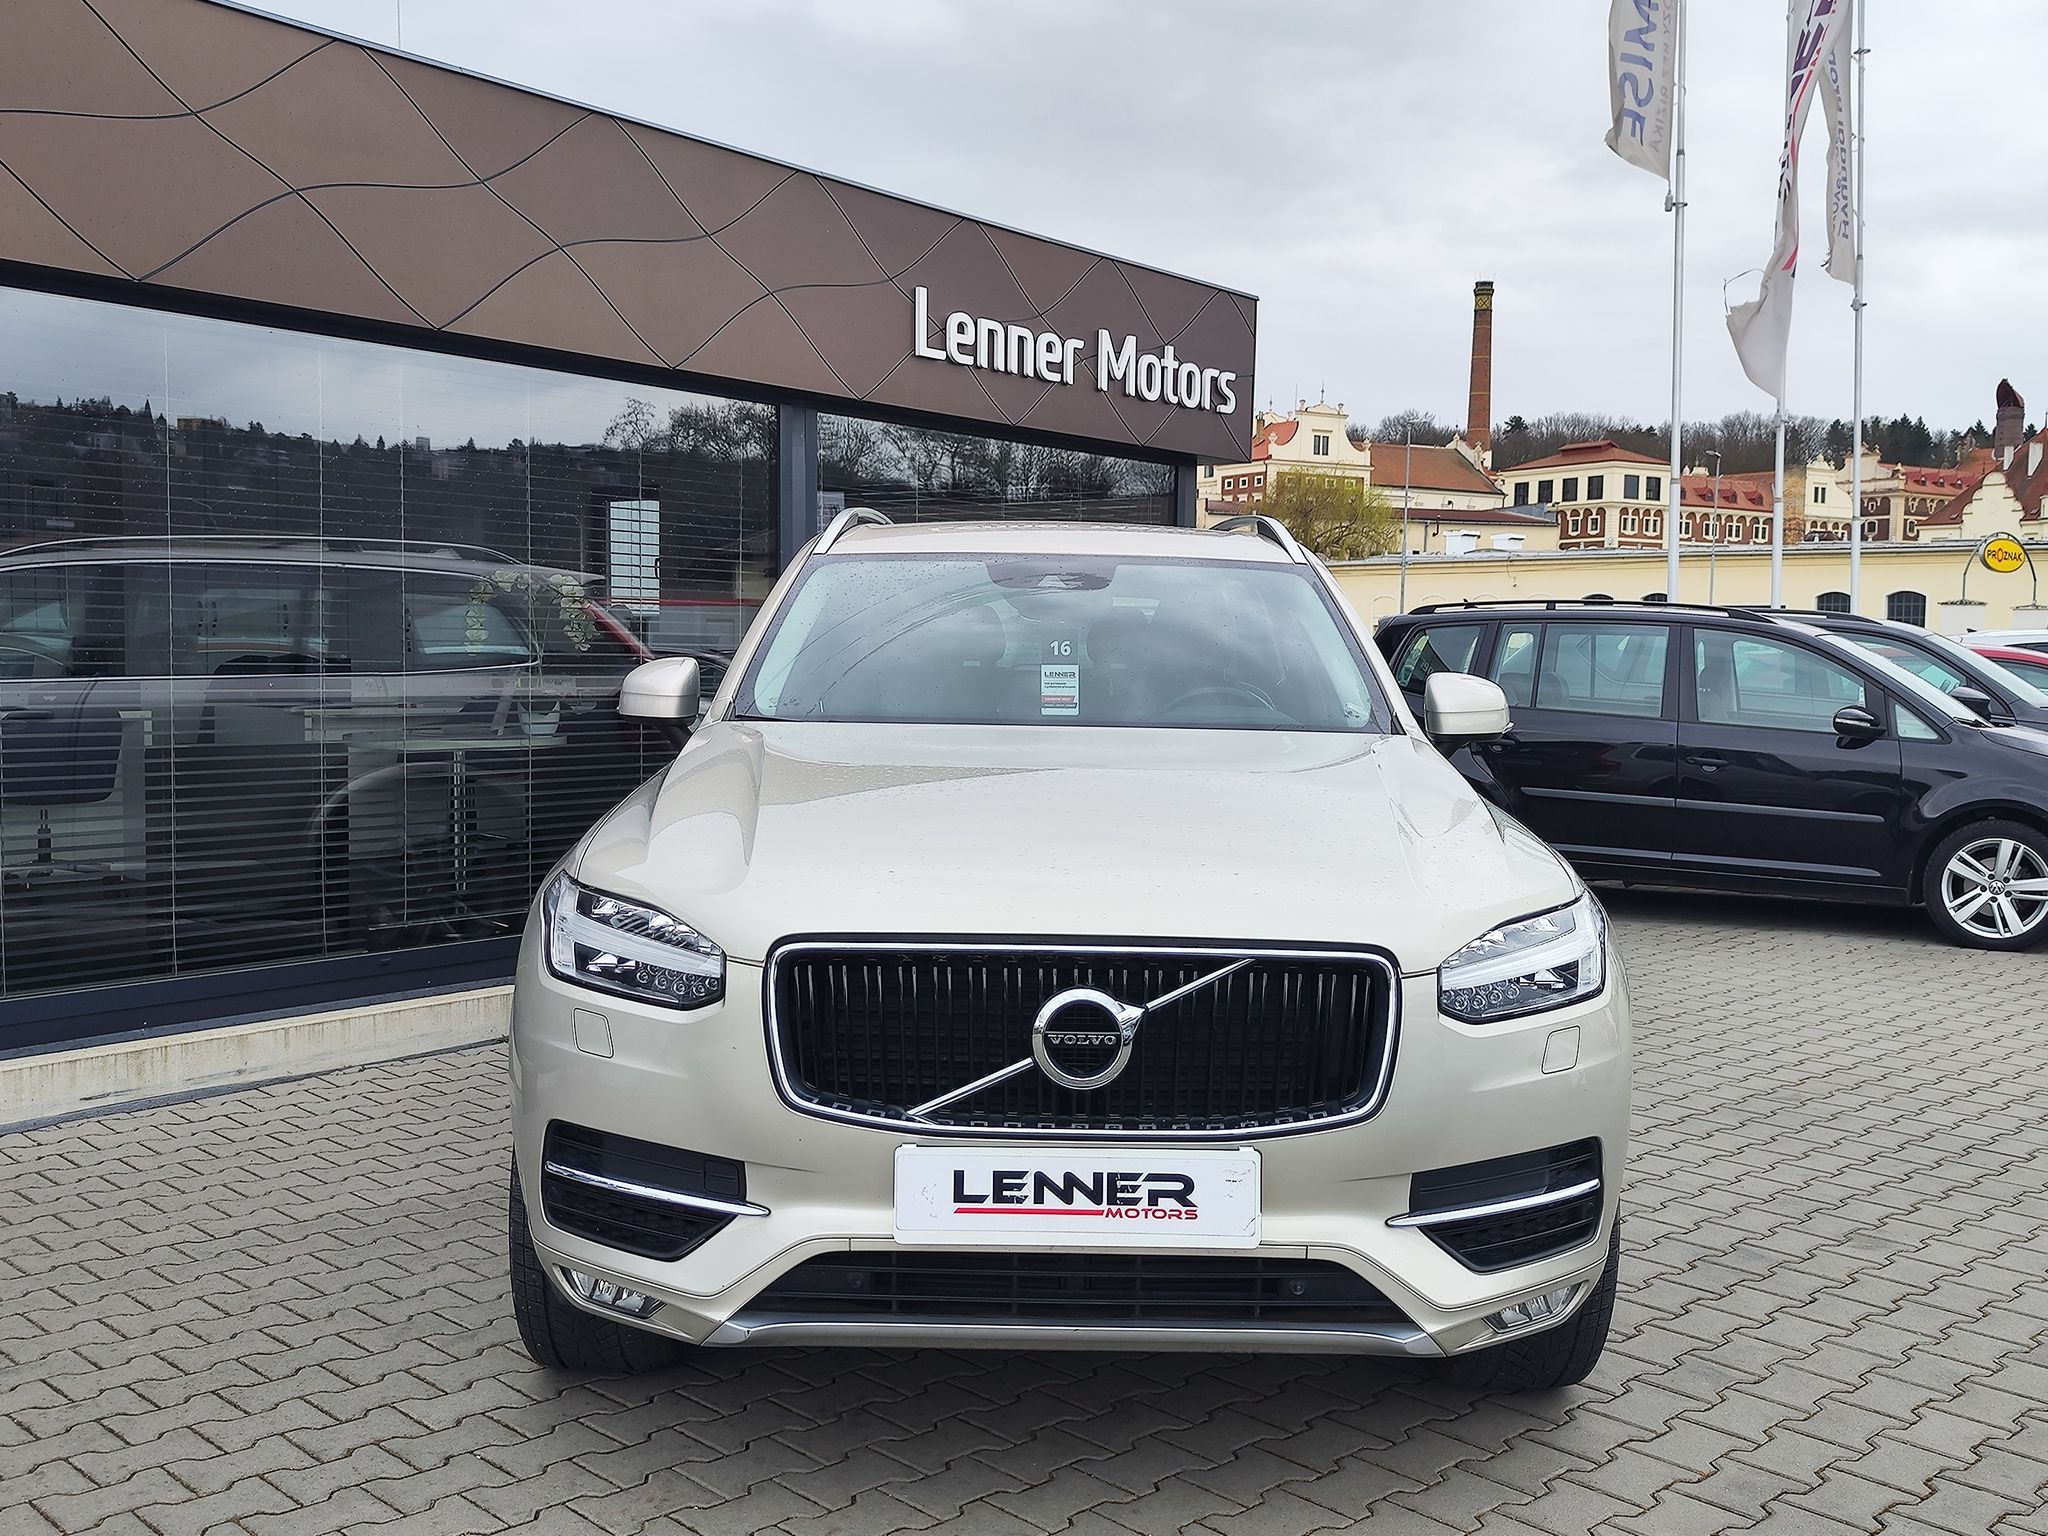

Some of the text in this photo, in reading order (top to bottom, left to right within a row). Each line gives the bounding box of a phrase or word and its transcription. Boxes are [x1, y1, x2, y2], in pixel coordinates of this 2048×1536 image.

[913, 285, 1237, 415] Lenner Motors
[1987, 548, 2022, 562] PROZNAK
[1050, 640, 1072, 656] 16
[1047, 1034, 1117, 1045] VOLVO
[953, 1169, 1198, 1208] LENNER
[1105, 1207, 1198, 1220] MOTORS
